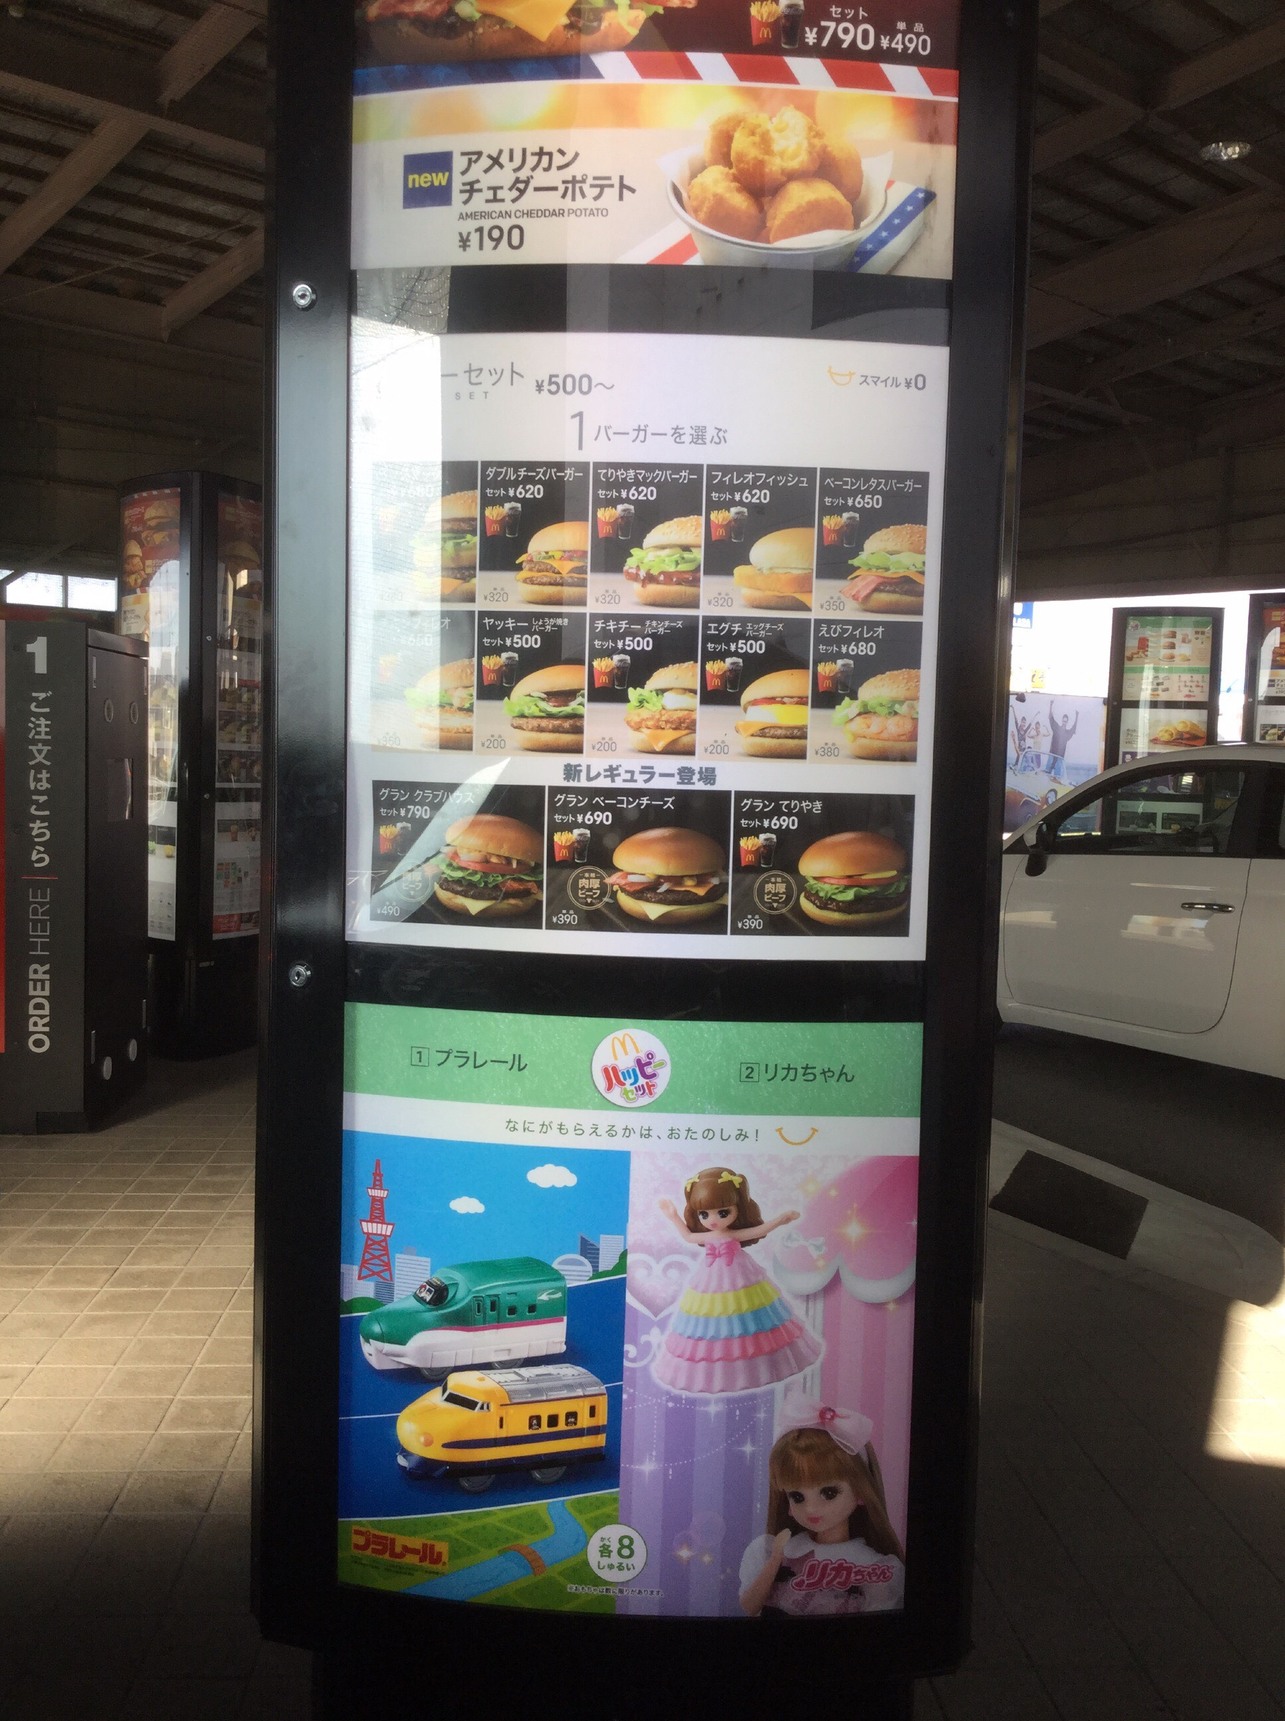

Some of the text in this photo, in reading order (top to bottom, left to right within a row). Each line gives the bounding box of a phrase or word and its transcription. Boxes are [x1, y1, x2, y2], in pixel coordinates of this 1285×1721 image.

[830, 4, 868, 20] セット
[896, 21, 924, 33] 単品
[804, 20, 931, 56] ¥790 ¥490
[460, 146, 580, 177] アメリカン
[407, 171, 449, 188] new
[459, 173, 637, 206] チェダーポテト
[458, 207, 609, 221] AMERICAN CHEDDAR POTATO
[458, 224, 525, 252] ¥190
[859, 373, 926, 391] スマイル ¥0
[570, 410, 728, 451] 1 バーガーを選ぶ
[485, 466, 584, 481] ダブルチーズバーガー
[597, 468, 698, 484] てりやきマックバーガー
[711, 471, 809, 487] フィレオフィッシュ
[485, 484, 544, 499] セット ¥620
[824, 477, 922, 492] ベーコンレタスバーガー
[597, 486, 657, 500] セット ¥620
[711, 489, 770, 503] セット ¥620
[824, 494, 883, 509] セット ¥650
[483, 591, 509, 603] ¥320
[595, 593, 621, 605] ¥320
[707, 596, 734, 608] ¥320
[819, 600, 846, 612] ¥350
[483, 617, 529, 631] ヤッキー
[532, 617, 569, 627] しょうが焼き
[532, 625, 559, 633] バーガー
[594, 619, 642, 634] チキチー
[644, 620, 684, 629] チキンチーズ
[707, 622, 742, 636] エグチ
[746, 622, 784, 632] エッグチーズ
[644, 627, 671, 635] バーガー
[746, 629, 773, 638] バーガー
[818, 623, 885, 639] えびフィレオ
[483, 634, 541, 649] セット ¥500
[594, 637, 653, 651] セット ¥500
[707, 639, 766, 654] セット ¥500
[818, 641, 877, 656] セット ¥680
[26, 636, 48, 674] 1
[481, 738, 506, 750] ¥200
[591, 741, 617, 752] ¥200
[703, 744, 730, 755] ¥200
[814, 746, 840, 758] ¥380
[28, 690, 52, 868] ご注文はこちら
[563, 762, 717, 786] 新レギュラー登場
[379, 787, 475, 805] グラン クラブハウス
[554, 794, 675, 811] グラン ベーコンチーズ
[379, 805, 430, 819] セット ¥790
[740, 799, 823, 814] グラン てりやき
[554, 811, 613, 826] セット ¥690
[740, 816, 799, 830] セット ¥690
[578, 878, 601, 889] 肉厚
[764, 883, 787, 894] 肉厚
[578, 889, 600, 898] ビーフ
[763, 893, 787, 902] ビーフ
[376, 905, 400, 917] ¥490
[552, 913, 578, 925] ¥390
[737, 919, 763, 930] ¥390
[28, 888, 50, 1054] ORDER HERE
[435, 1048, 528, 1073] プラレール
[602, 1051, 667, 1093] ハッピー
[764, 1063, 855, 1083] リカちゃん
[621, 1081, 657, 1102] セット
[353, 1528, 443, 1565] プラレール
[600, 1536, 612, 1544] かく
[597, 1561, 636, 1572] しゅるい
[791, 1560, 893, 1591] リカちゃん
